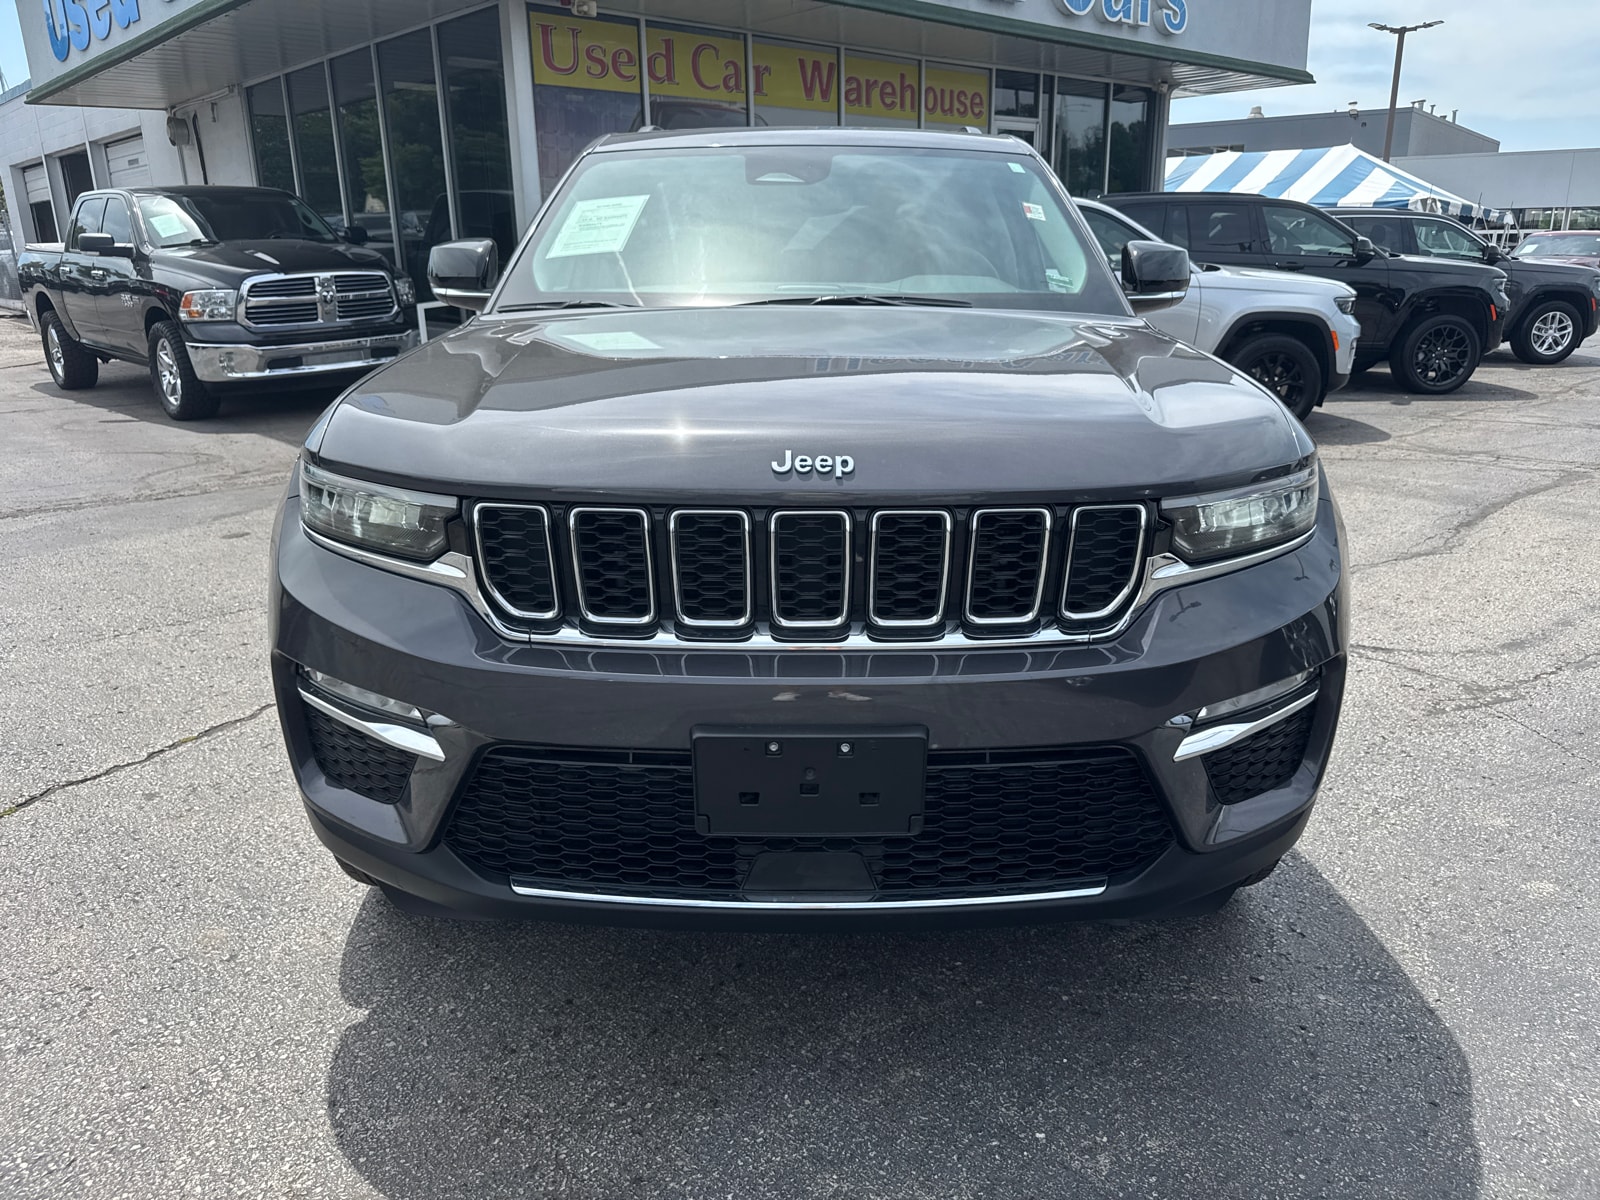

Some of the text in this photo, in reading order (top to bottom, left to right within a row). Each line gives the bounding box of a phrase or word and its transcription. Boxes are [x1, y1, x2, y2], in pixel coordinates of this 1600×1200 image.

[536, 23, 984, 119] Used Car Warehouse
[771, 449, 855, 478] Jeep
